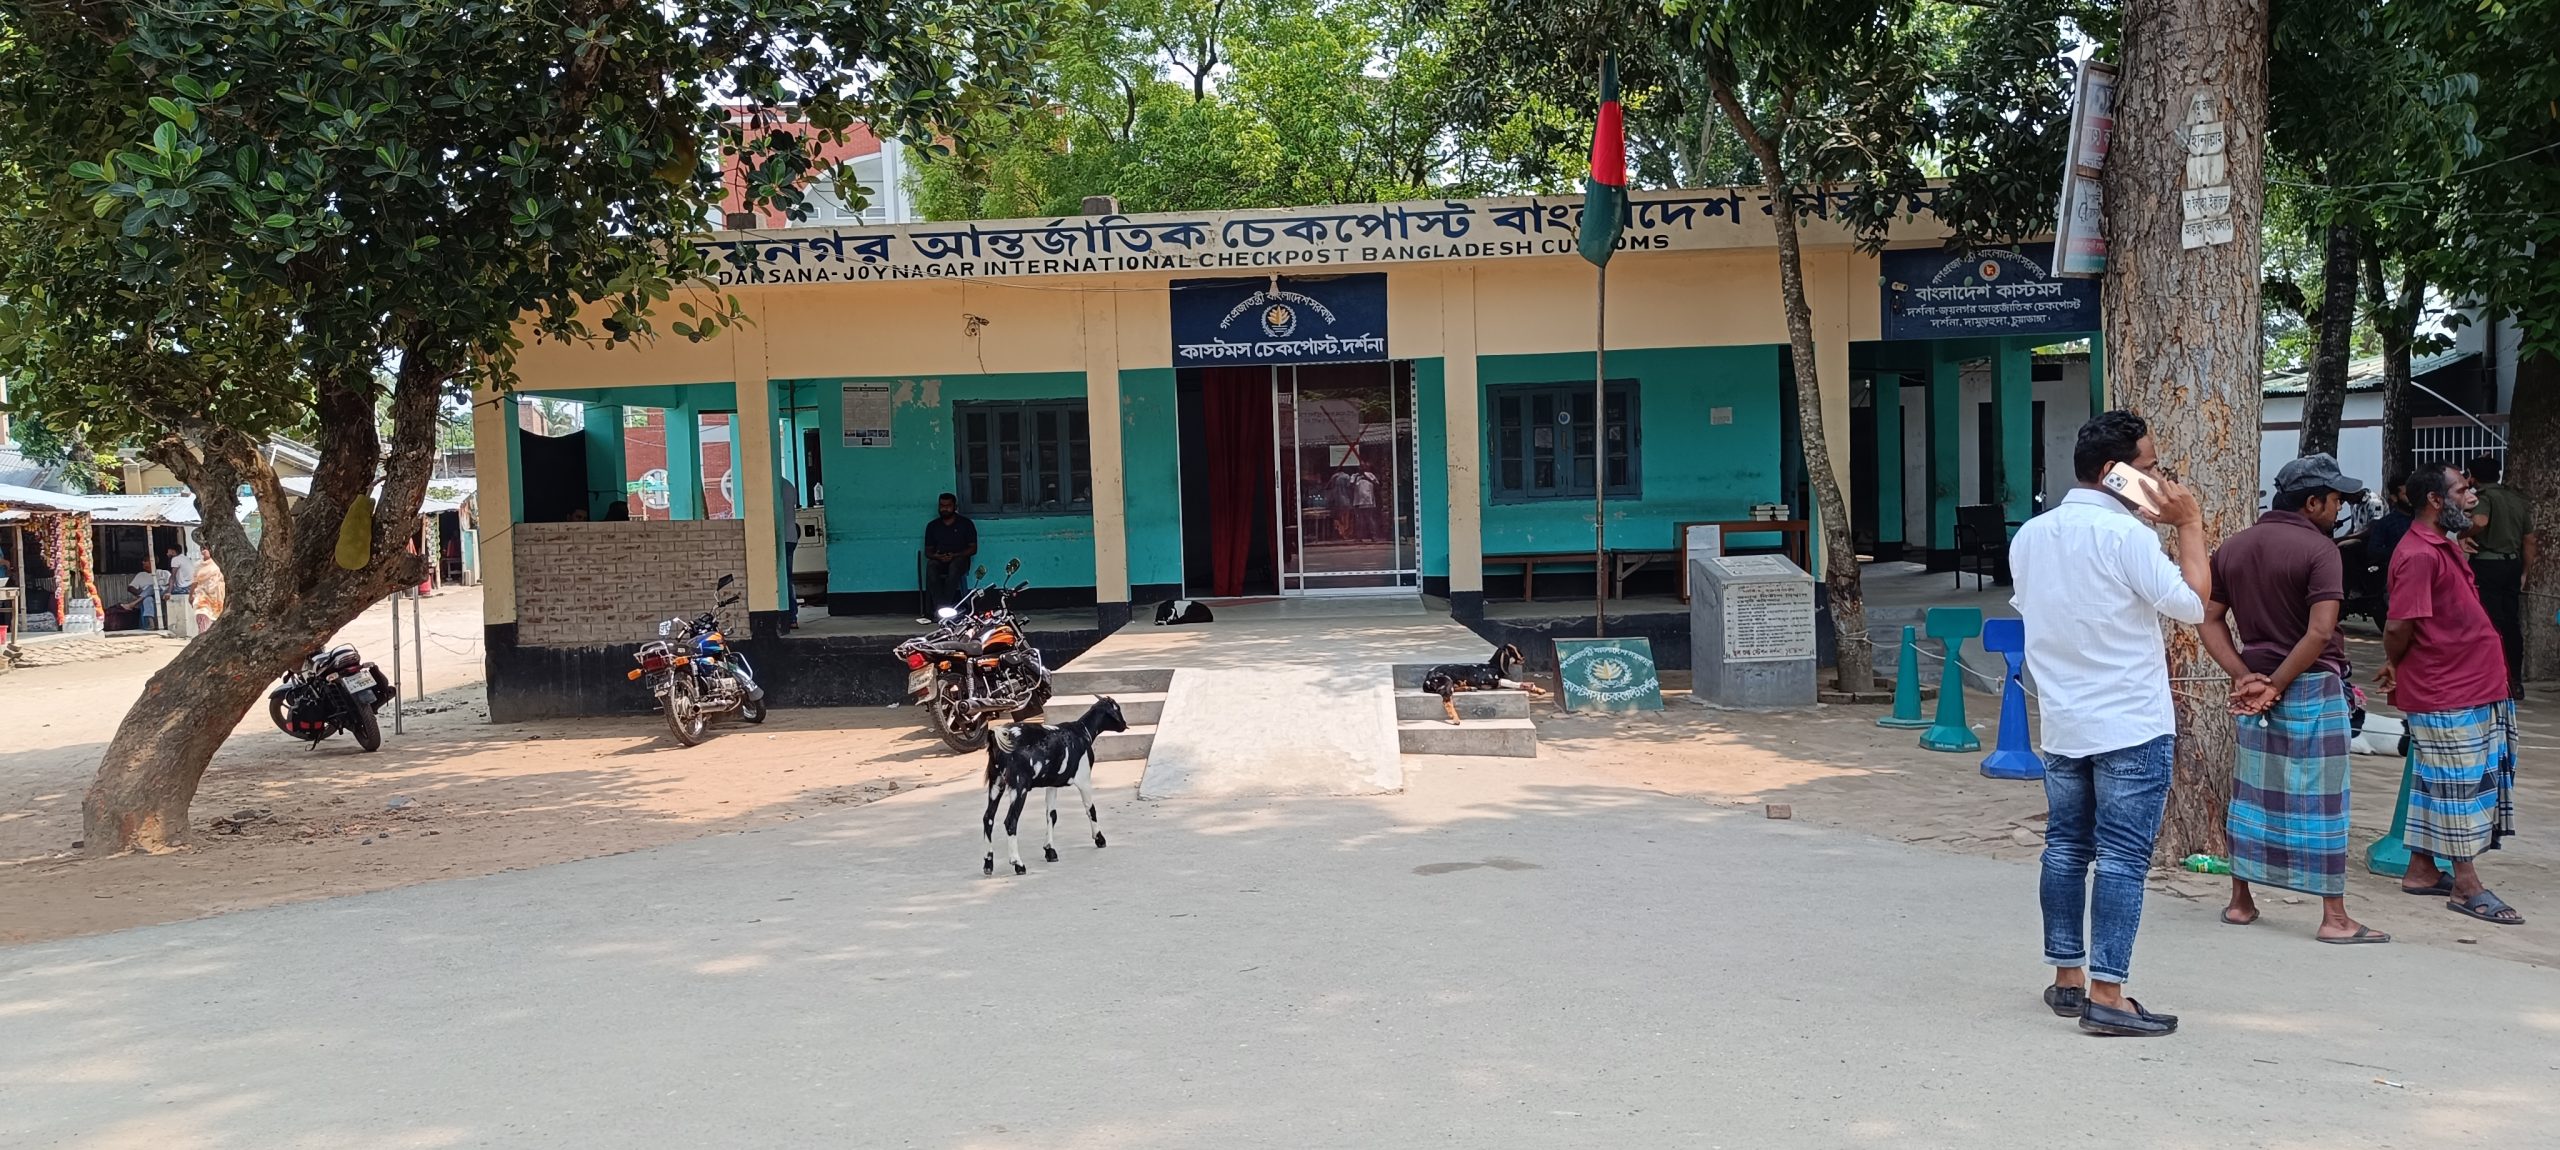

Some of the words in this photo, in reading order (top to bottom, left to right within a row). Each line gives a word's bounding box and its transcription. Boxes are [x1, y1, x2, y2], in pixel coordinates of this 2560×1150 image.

[909, 215, 1211, 260] আন্তর্জাতিক
[1222, 200, 1476, 248] চেকপোস্ট
[1488, 189, 1746, 235] বাংাদেশ
[984, 254, 1191, 277] INTERNATIONAL
[1200, 248, 1349, 268] CHECKPOST
[1362, 241, 1532, 262] BANGLADESH
[1542, 234, 1669, 254] CUOMS
[1915, 283, 1991, 302] বাংলাদেশ
[1996, 279, 2063, 299] কাস্টমস
[2034, 298, 2081, 311] চেকপোস্ট
[1178, 337, 1252, 360] কাস্টমস
